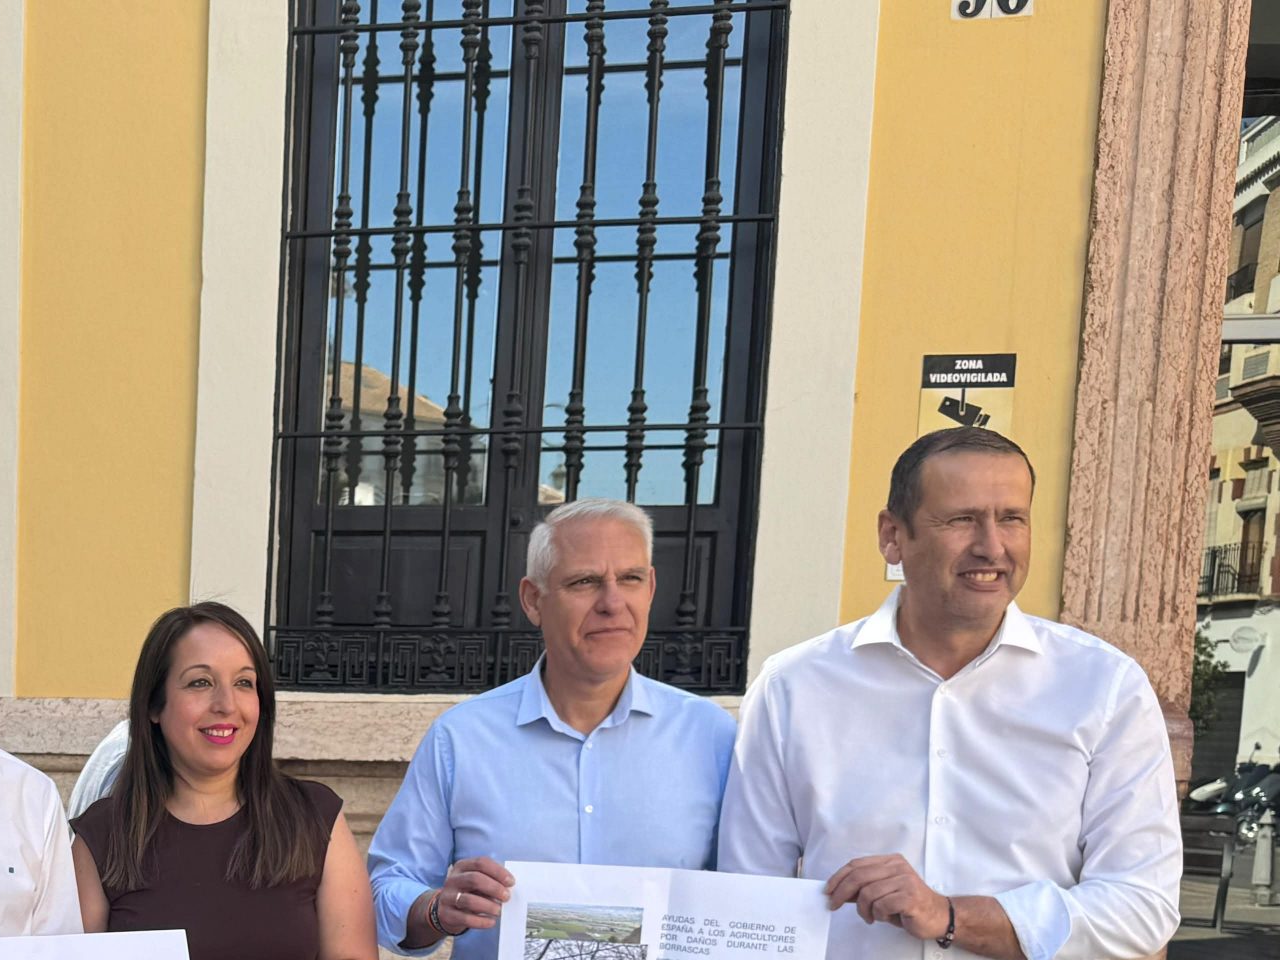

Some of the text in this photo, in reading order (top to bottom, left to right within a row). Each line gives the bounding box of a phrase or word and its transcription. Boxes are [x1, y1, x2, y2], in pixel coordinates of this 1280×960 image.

[955, 360, 983, 369] ZONA
[929, 372, 1007, 383] VIDEOVIGILADA
[663, 914, 796, 934] AYUDAS DEL GOBIERNO DE
[661, 923, 693, 934] ESPAÑA
[729, 931, 795, 943] AGRICULTORES
[659, 943, 710, 955] BORRASCAS
[661, 933, 794, 953] POR DAÑOS DURANTE LAS
